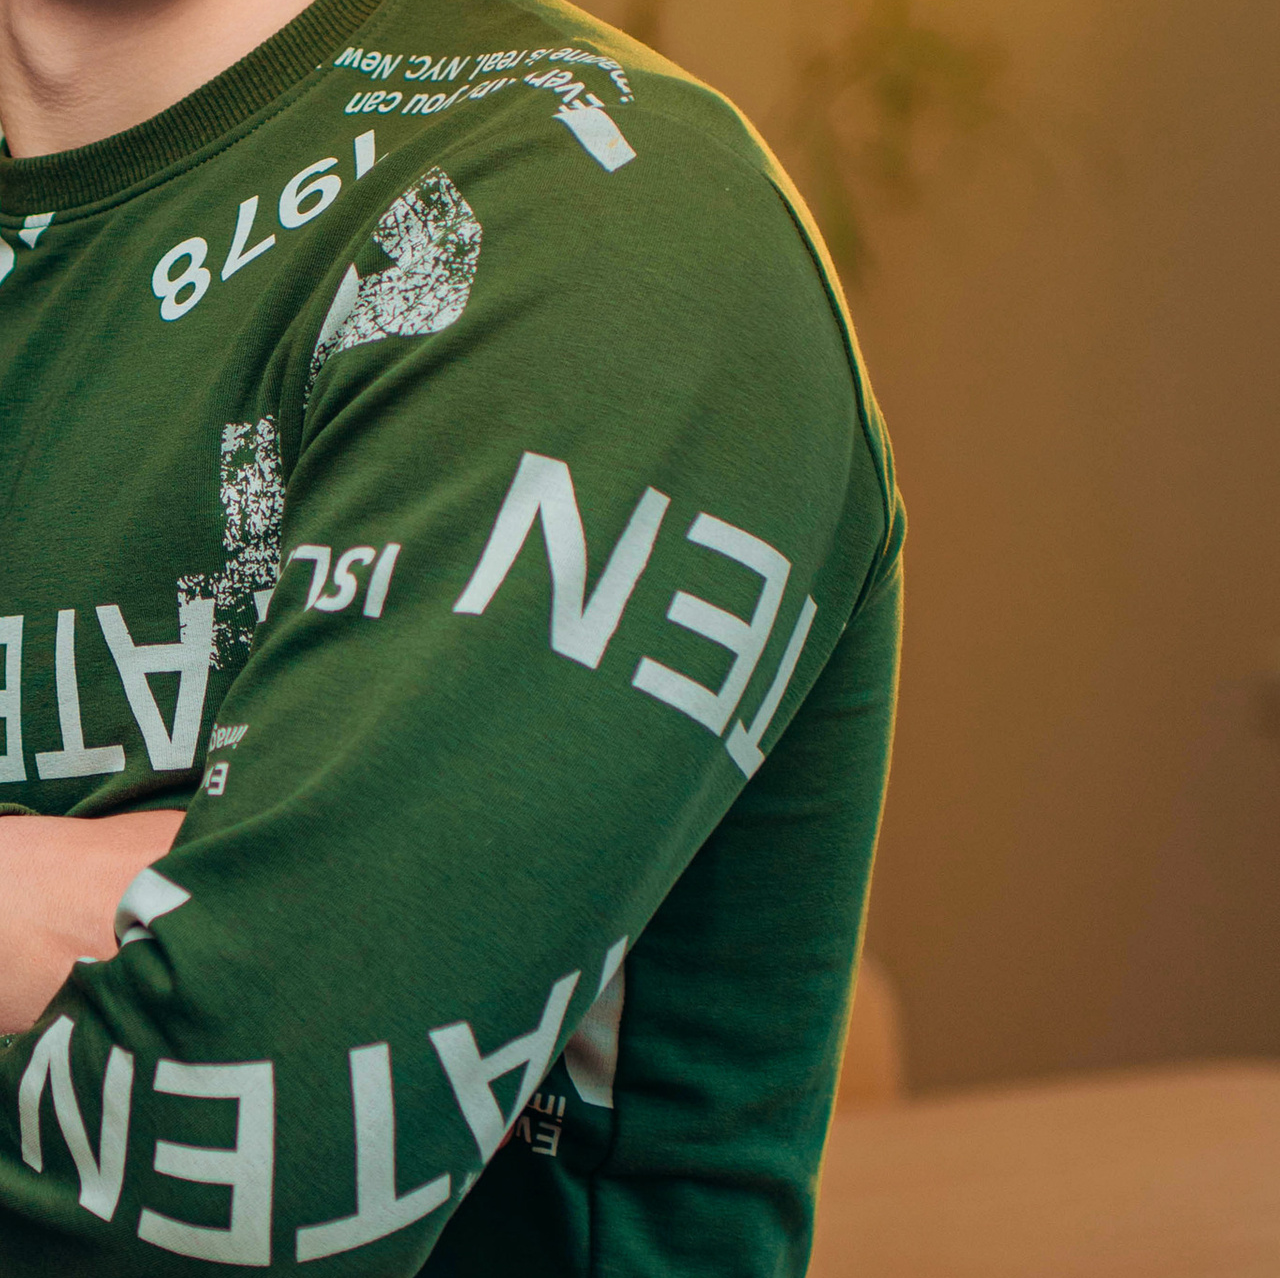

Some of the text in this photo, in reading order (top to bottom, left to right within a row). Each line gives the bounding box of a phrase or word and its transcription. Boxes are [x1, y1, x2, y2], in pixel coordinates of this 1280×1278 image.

[333, 45, 404, 82] New
[402, 53, 470, 82] NYC.
[468, 49, 528, 80] real.
[343, 89, 404, 116] can
[152, 129, 388, 321] 1978
[284, 542, 401, 619] ISL
[20, 962, 586, 1268] ATEN
